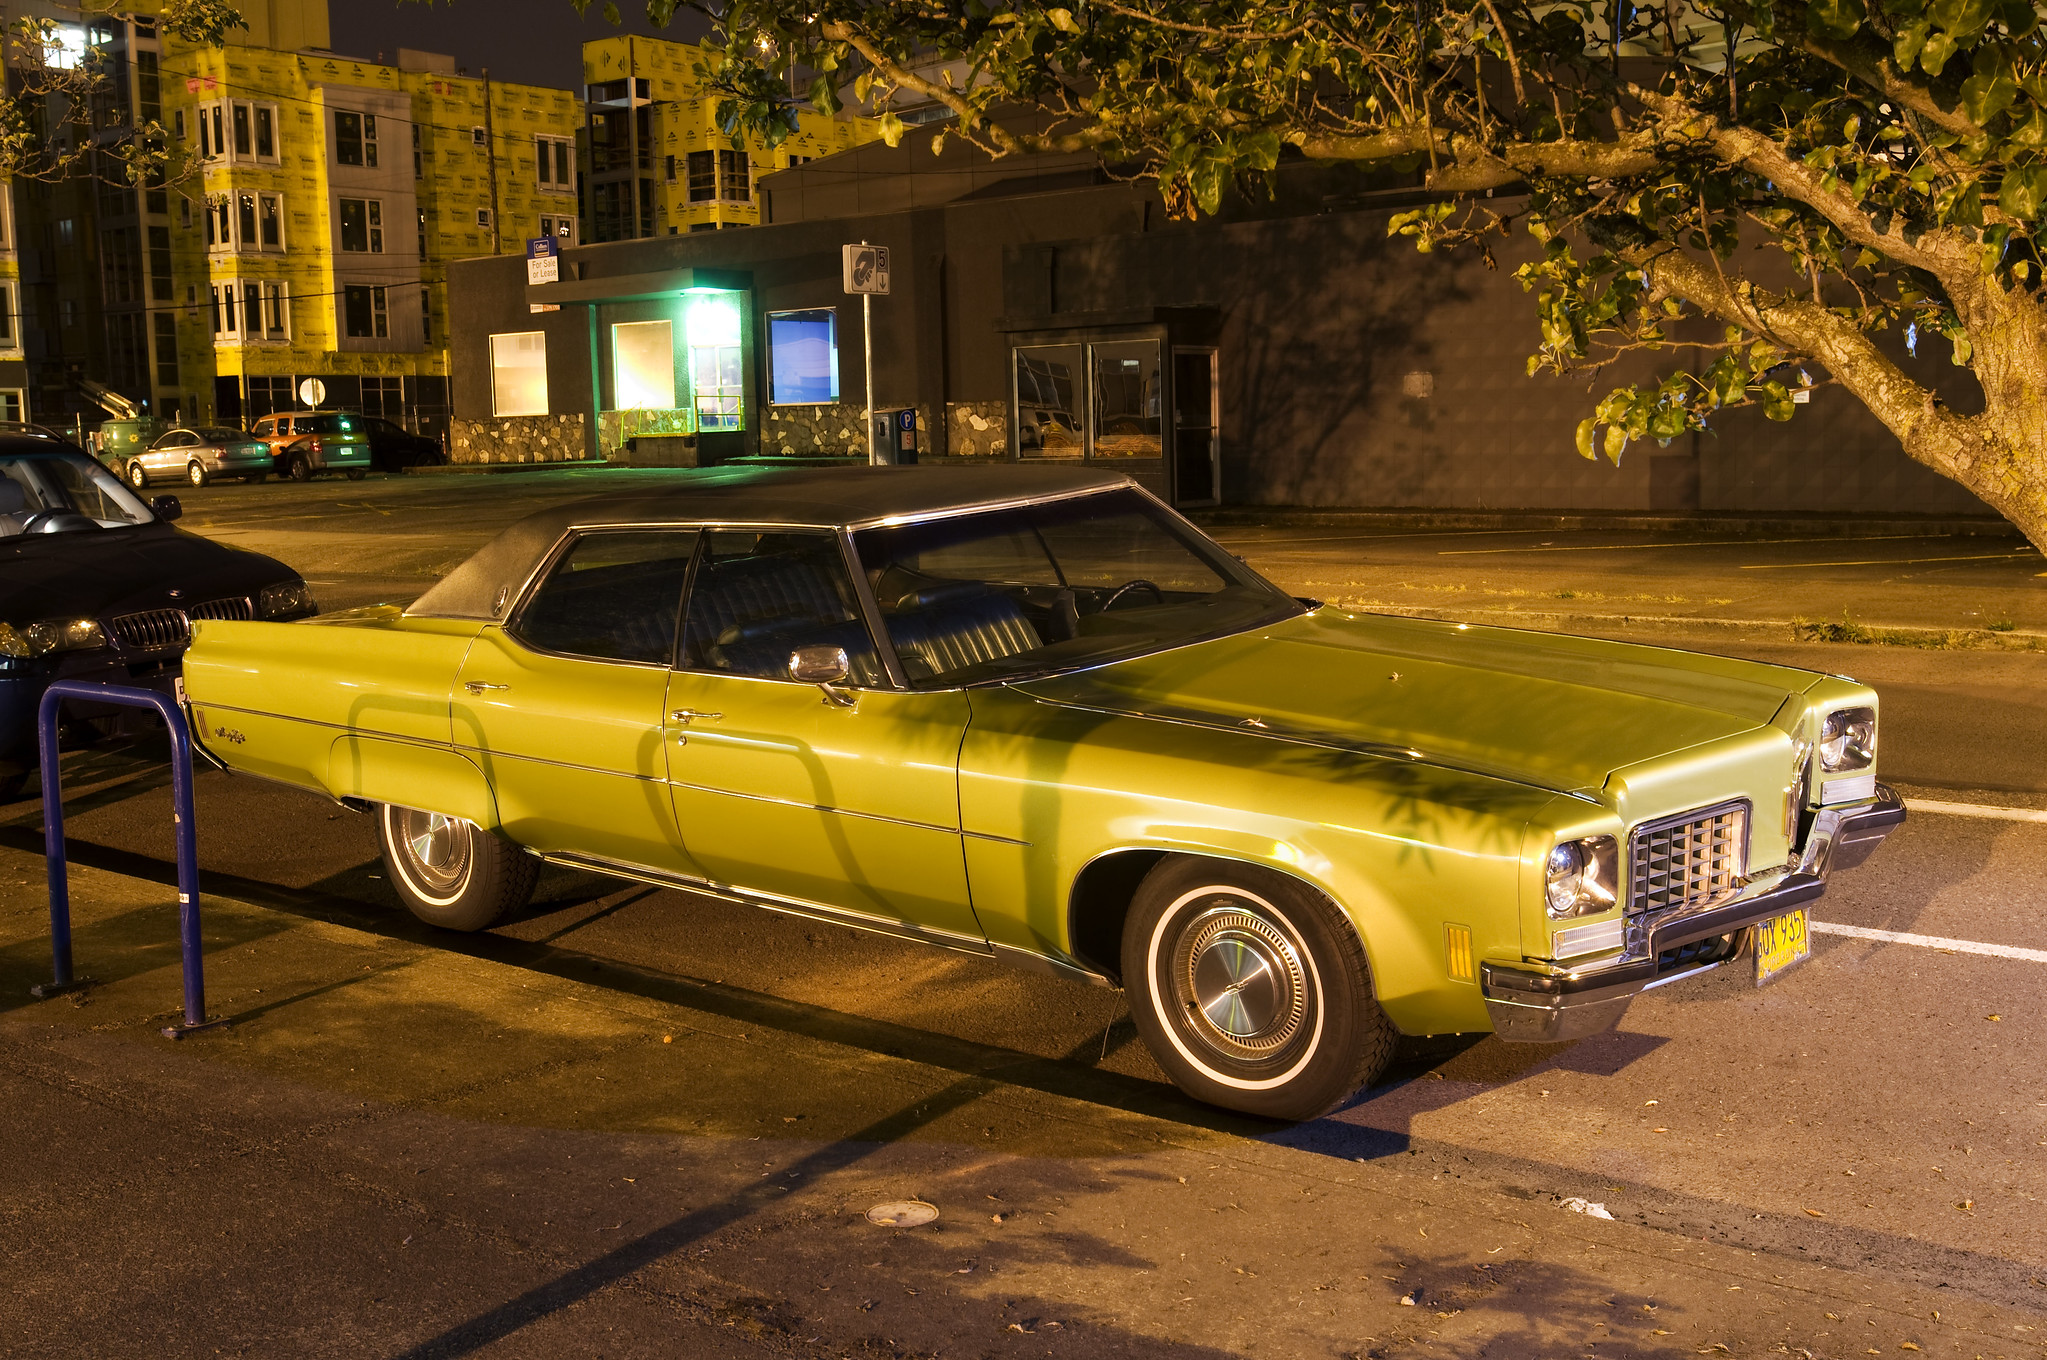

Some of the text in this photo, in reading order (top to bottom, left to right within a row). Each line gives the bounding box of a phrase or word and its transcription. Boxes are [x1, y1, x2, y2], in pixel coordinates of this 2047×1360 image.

[532, 259, 556, 269] For Sale
[879, 250, 886, 268] 5
[532, 269, 557, 279] or Lease
[904, 413, 911, 428] P
